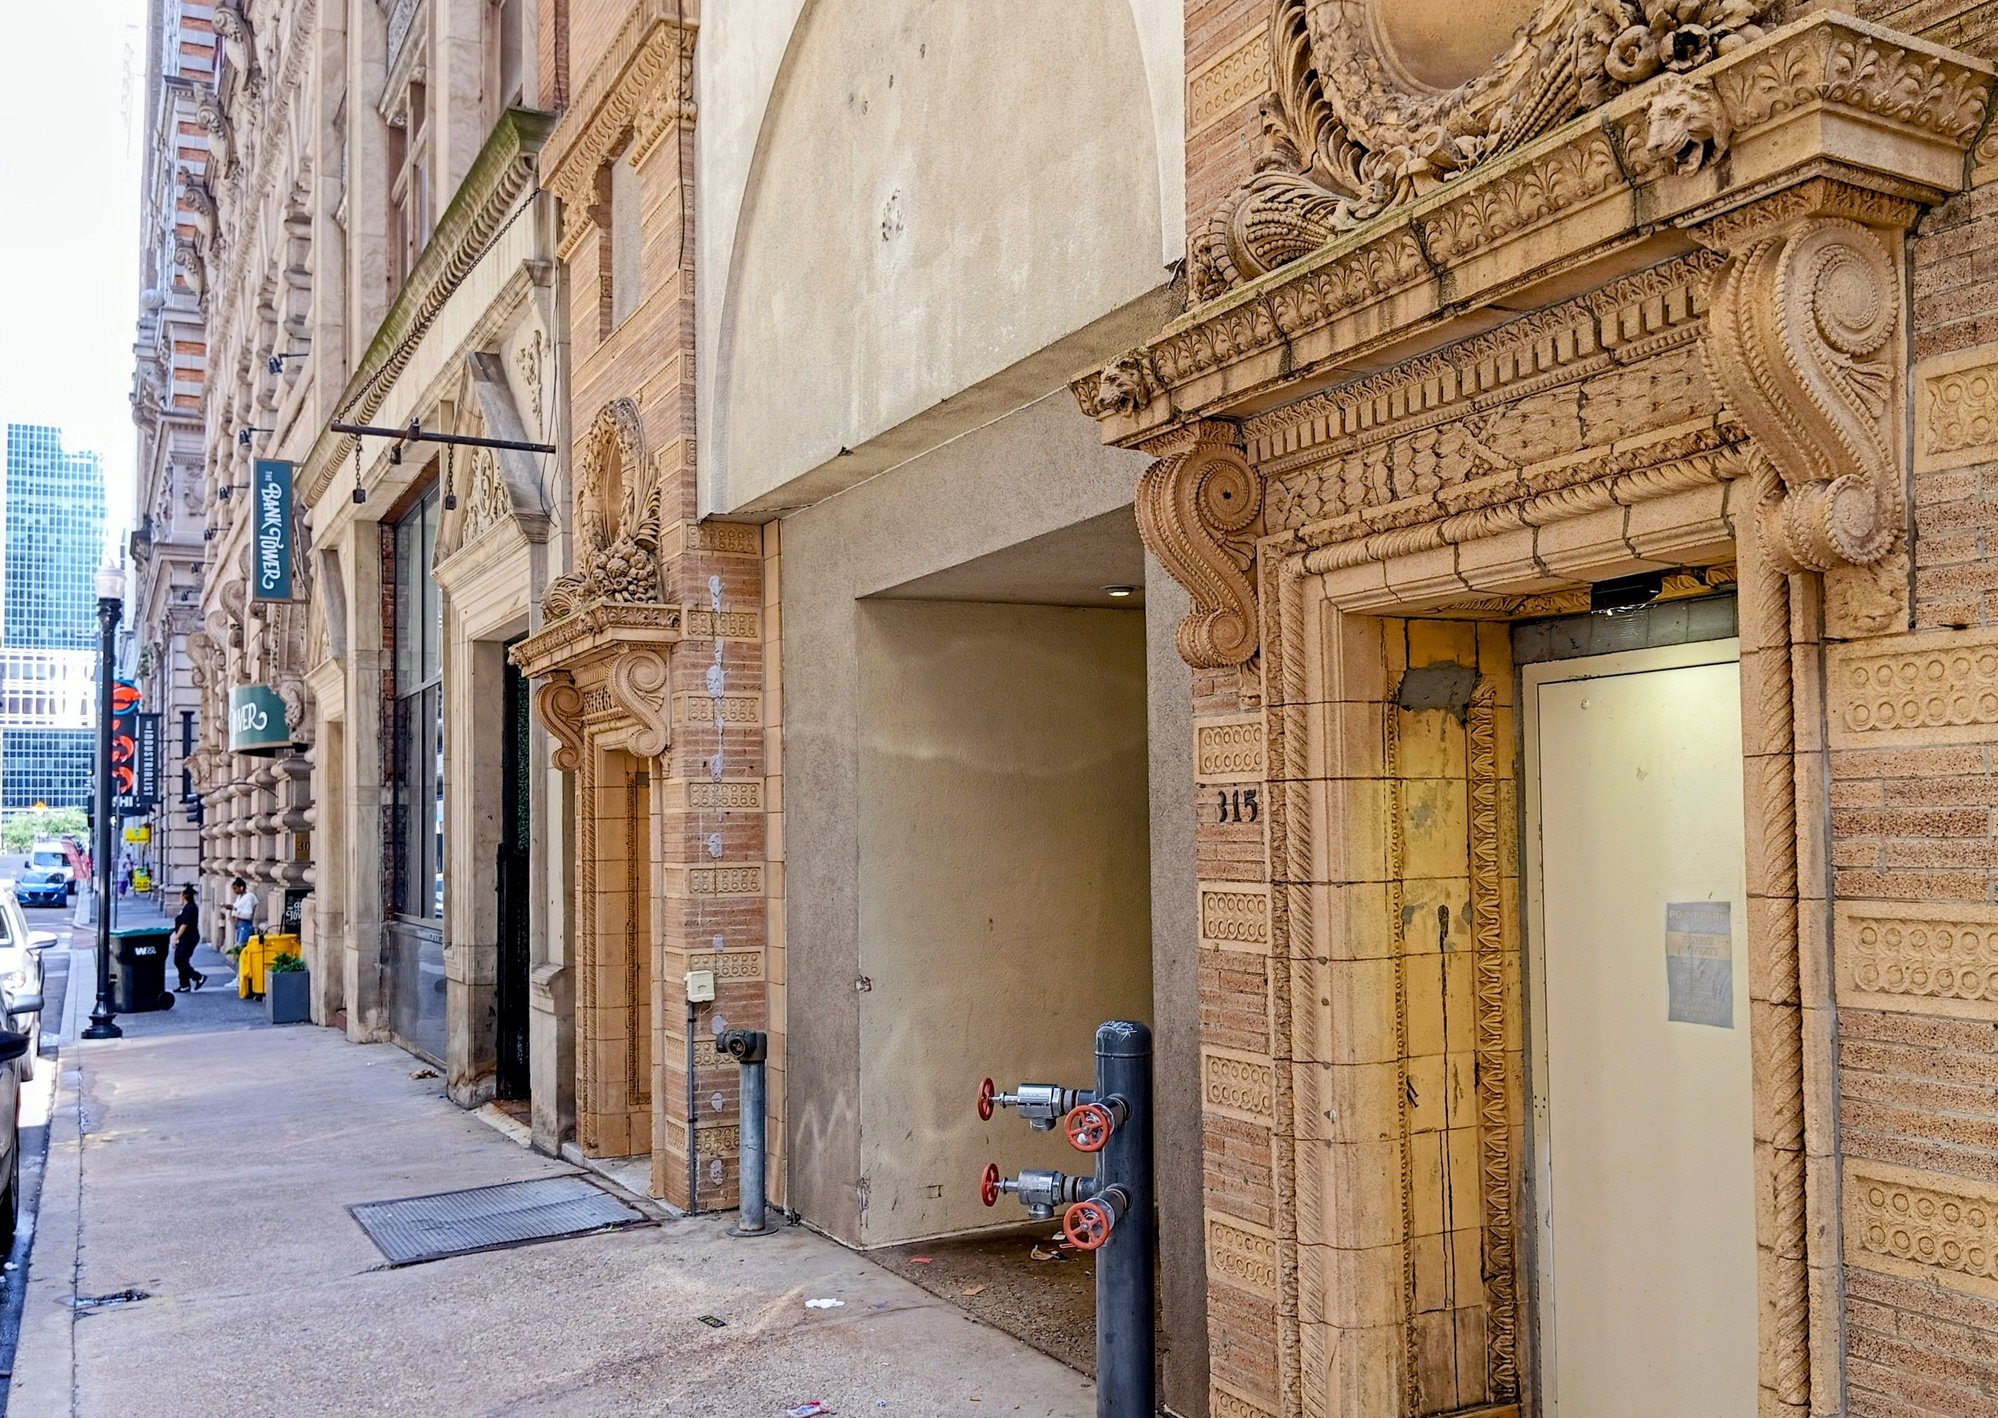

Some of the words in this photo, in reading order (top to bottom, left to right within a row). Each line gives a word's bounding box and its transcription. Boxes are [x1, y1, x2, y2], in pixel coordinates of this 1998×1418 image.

[265, 471, 273, 482] THE
[261, 482, 283, 530] BANK
[259, 528, 285, 590] TOWER
[143, 730, 154, 797] INDUSTRIALIST
[1217, 788, 1259, 823] 315
